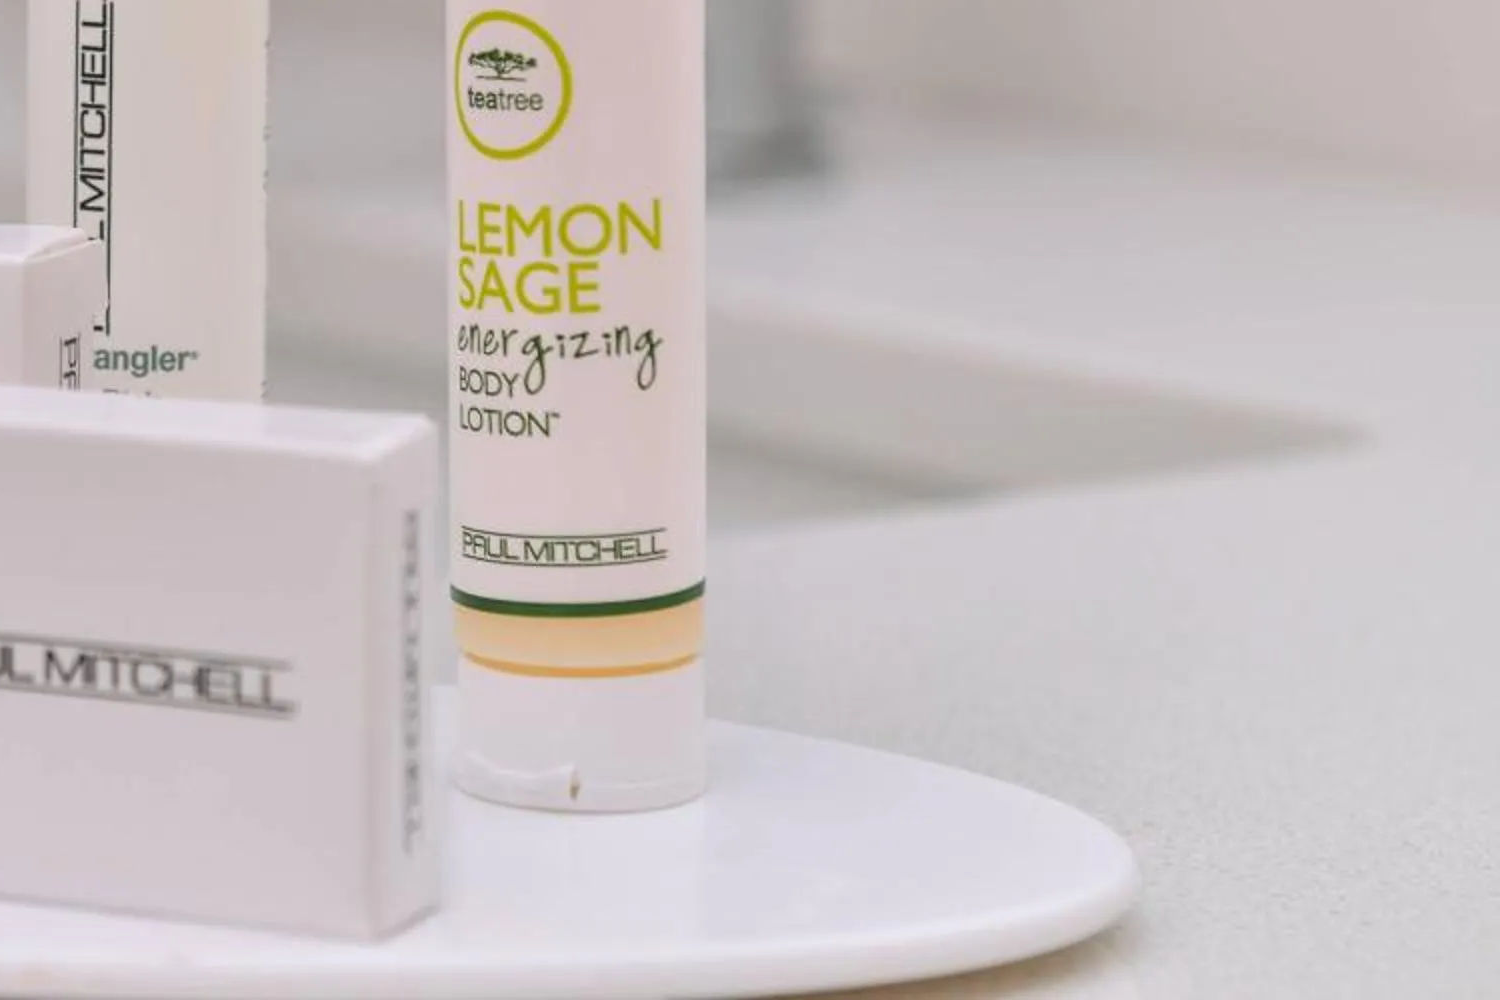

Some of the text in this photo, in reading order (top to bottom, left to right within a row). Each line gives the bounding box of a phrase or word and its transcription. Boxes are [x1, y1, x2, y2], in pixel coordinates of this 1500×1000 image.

[79, 0, 108, 213] MITCHELL
[468, 87, 544, 112] teatree
[458, 198, 663, 257] LEMON
[457, 256, 602, 316] SAGE
[457, 323, 664, 395] energizing
[460, 366, 519, 398] BODY
[462, 531, 668, 562] PAUL MITCHELL
[44, 649, 295, 713] MITCHELL
